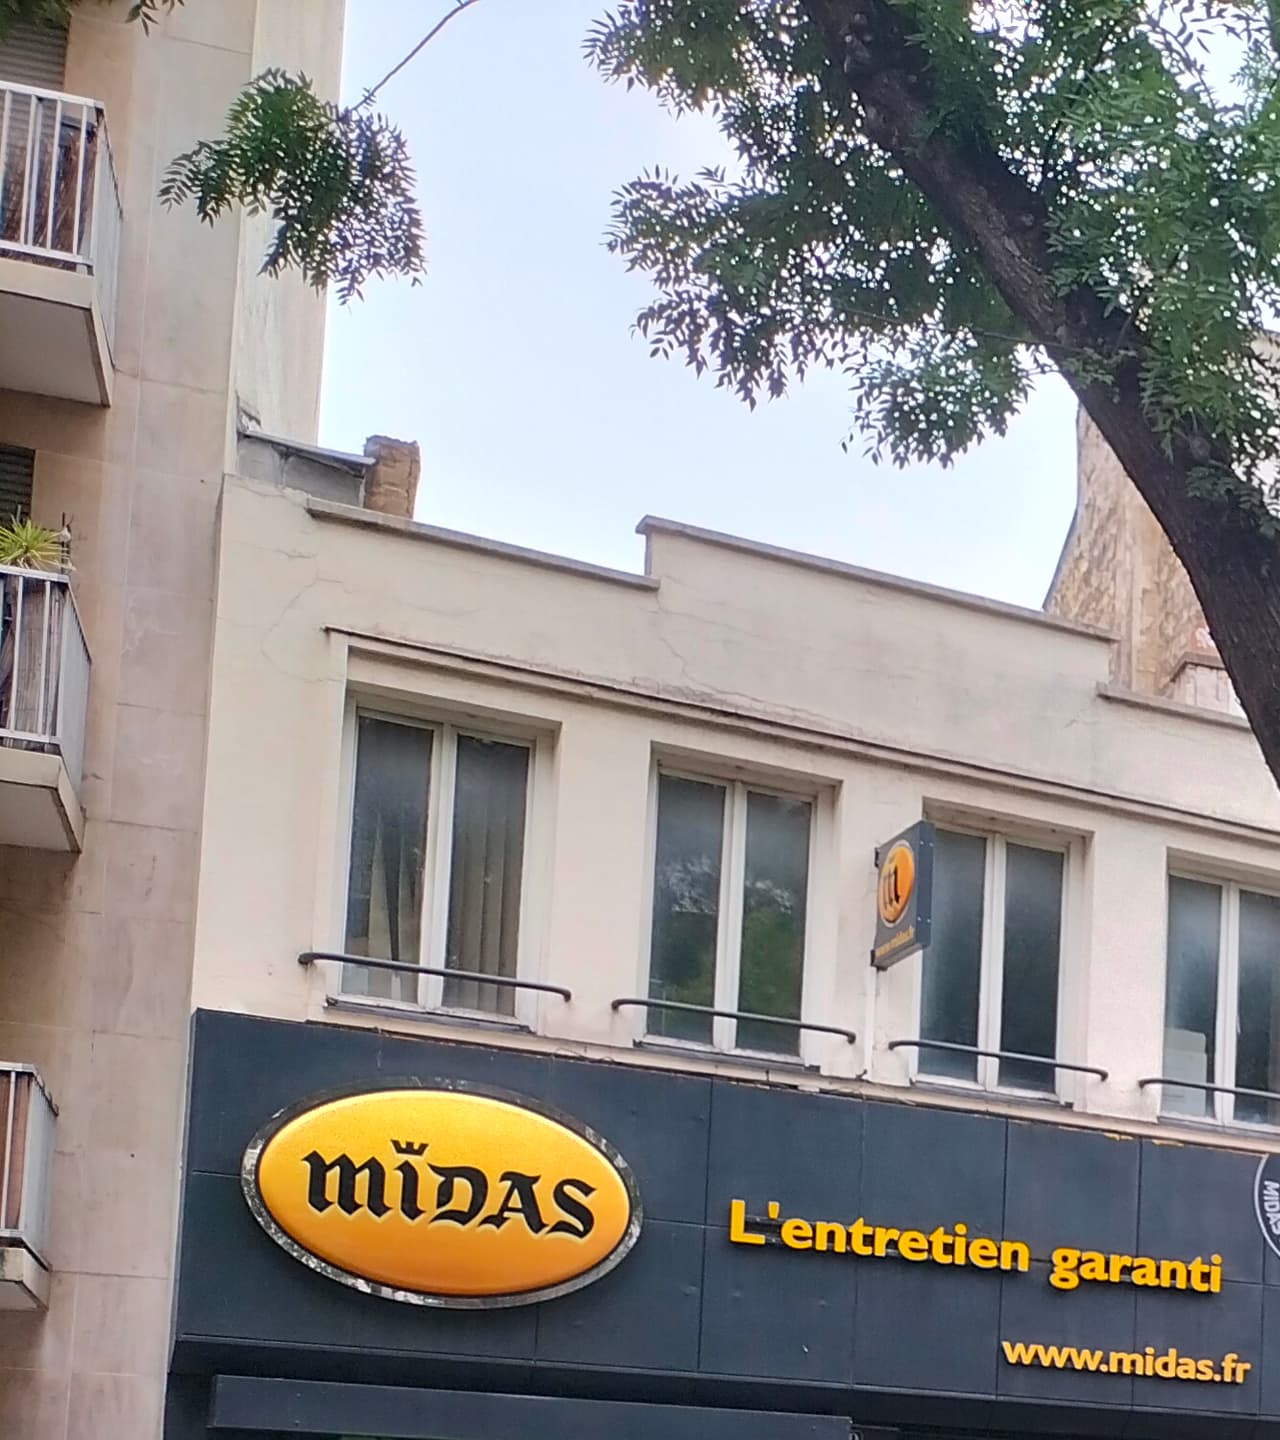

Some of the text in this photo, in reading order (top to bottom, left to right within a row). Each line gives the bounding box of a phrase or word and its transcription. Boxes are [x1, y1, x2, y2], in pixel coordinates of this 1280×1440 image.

[729, 1199, 1223, 1293] L'entretien garanti
[1001, 1341, 1251, 1383] www.midas.fr
